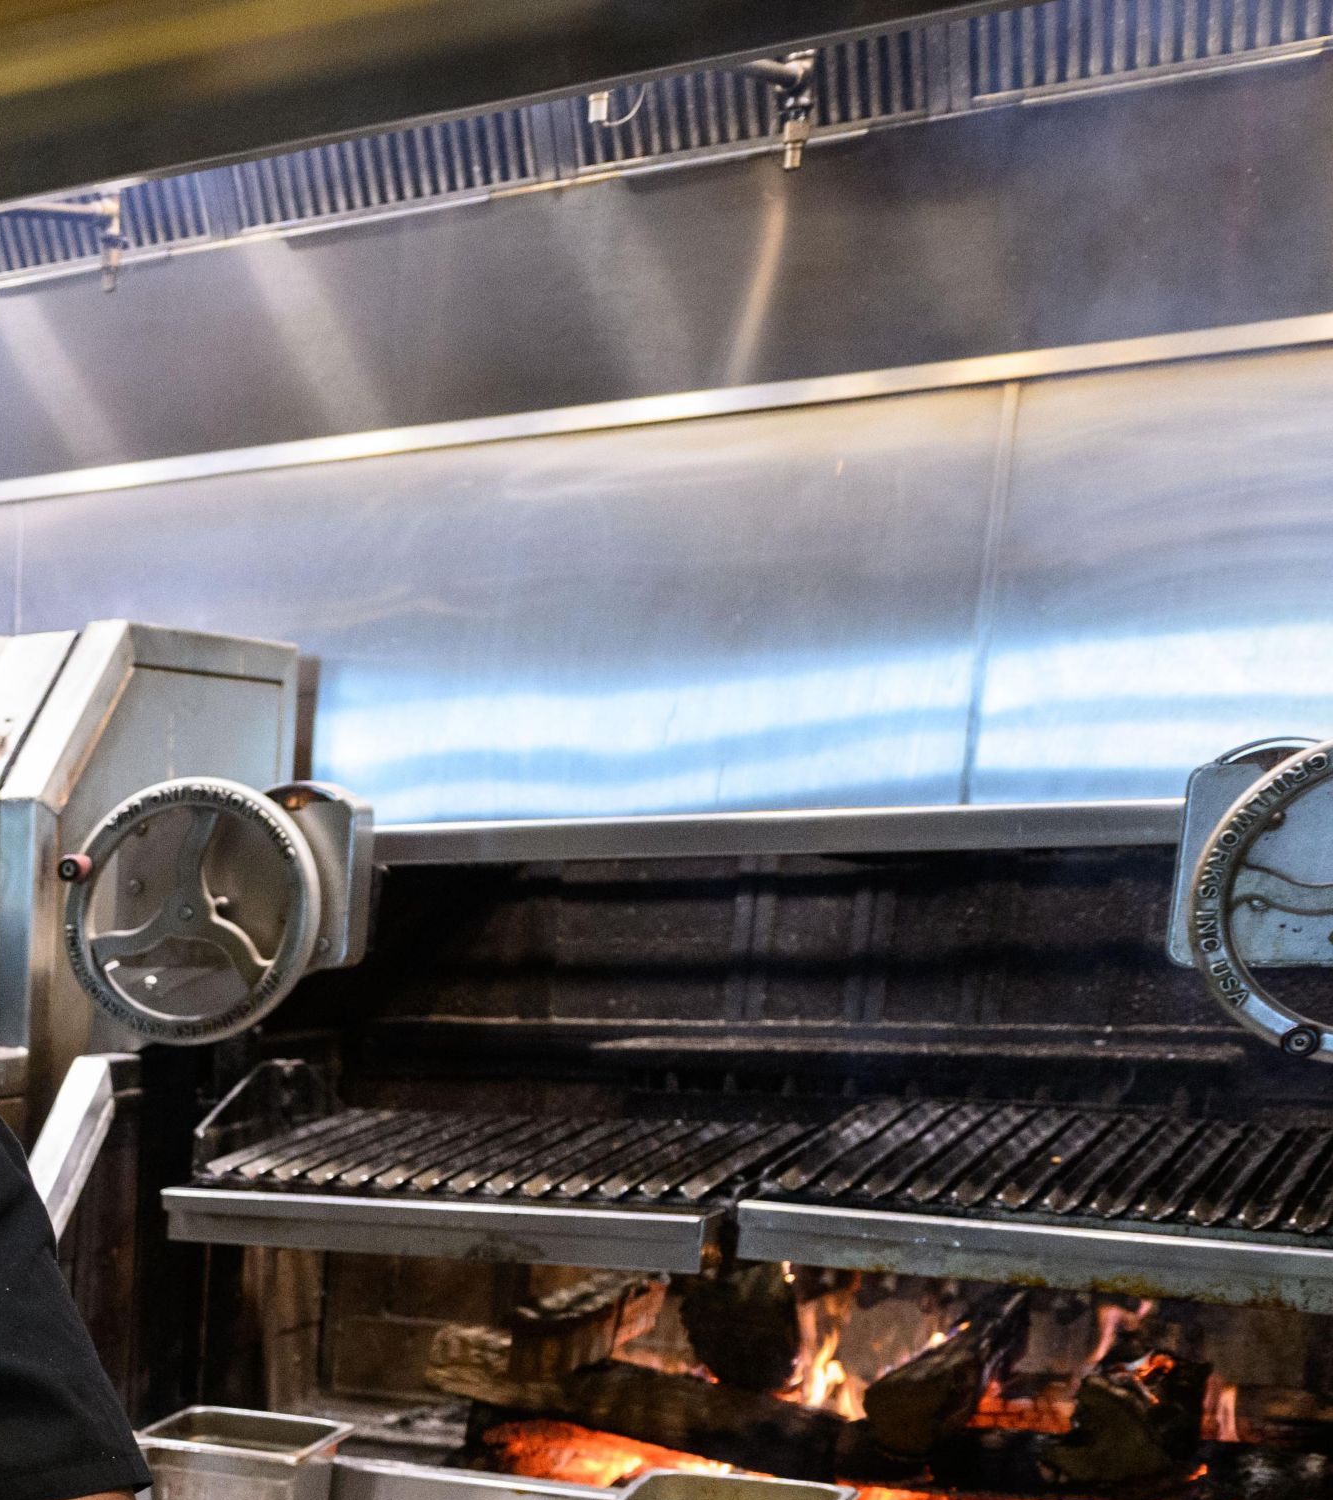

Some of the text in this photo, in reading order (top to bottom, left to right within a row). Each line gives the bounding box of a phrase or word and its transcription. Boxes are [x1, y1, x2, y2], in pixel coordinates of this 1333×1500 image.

[1196, 752, 1328, 1007] GRILLWORKS INC USA
